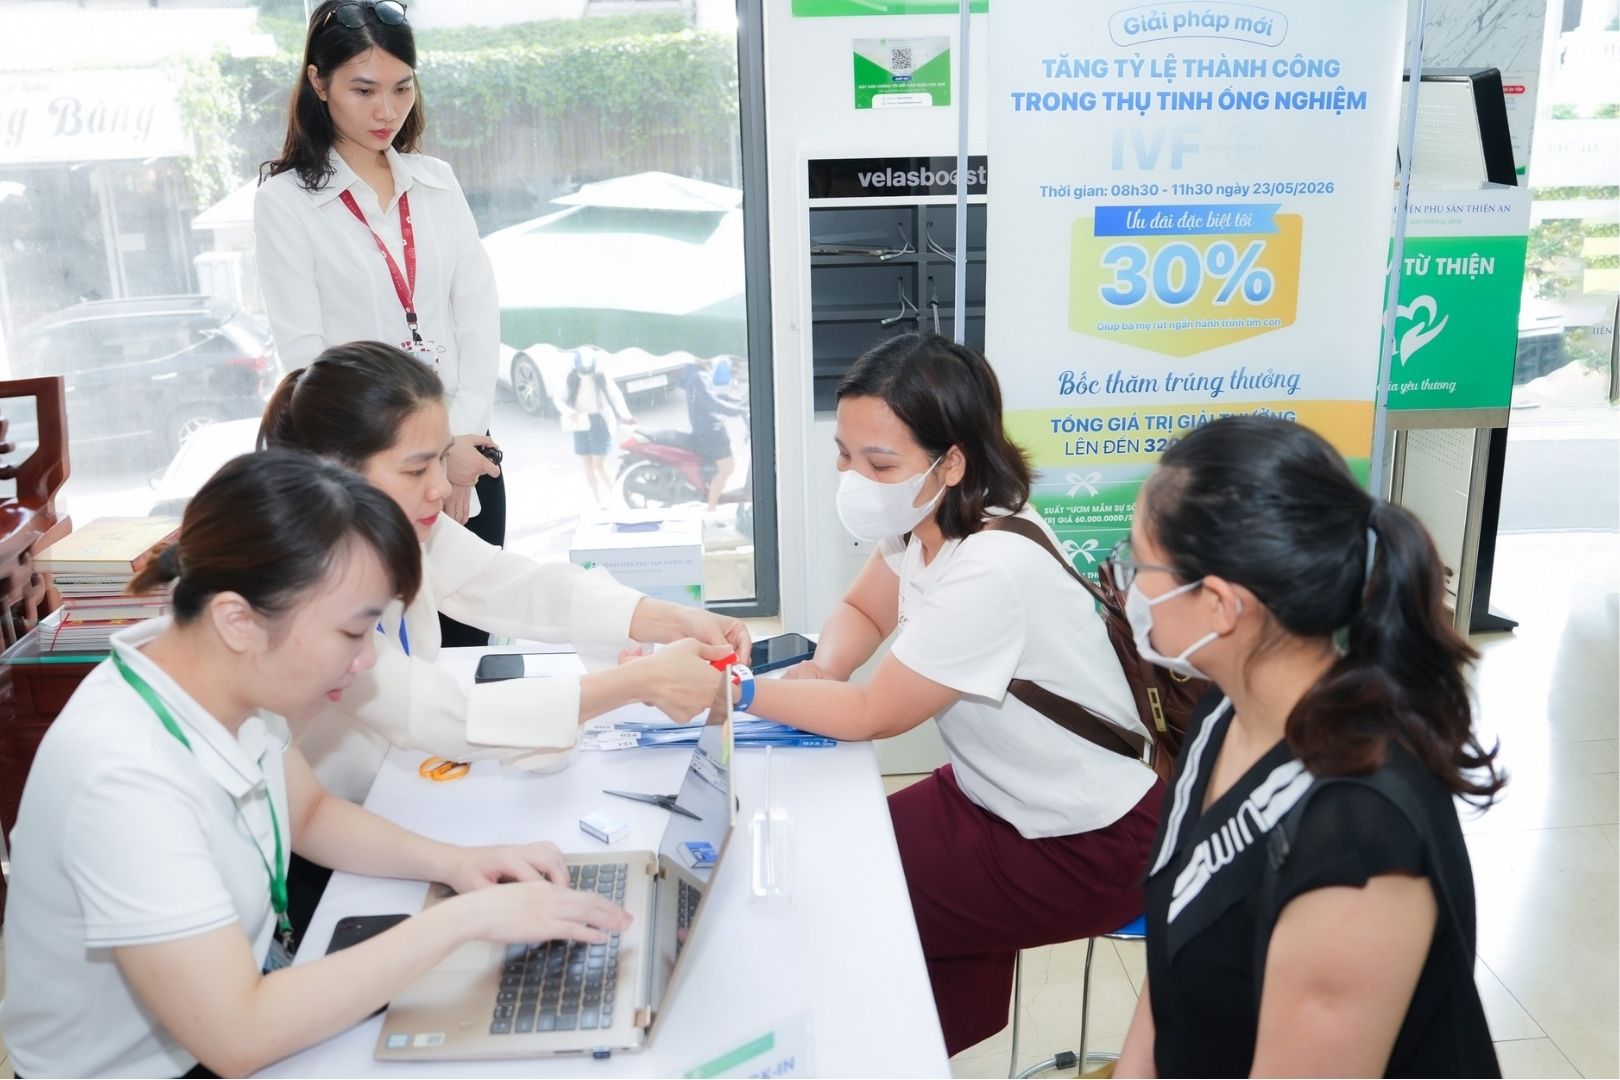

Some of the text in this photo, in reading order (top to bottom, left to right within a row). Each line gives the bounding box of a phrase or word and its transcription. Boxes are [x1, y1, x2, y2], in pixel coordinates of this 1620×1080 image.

[1123, 8, 1274, 37] Giải pháp mới
[1041, 52, 1341, 83] TĂNG TỶ LỆ THÀNH CÔNG
[1011, 85, 1367, 117] TRONG THỤ TINH ỐNG NGHIỆM
[1110, 122, 1199, 171] IVF
[1039, 184, 1072, 198] Thời
[1074, 185, 1108, 200] gian:
[1111, 183, 1159, 197] 08h30
[1171, 182, 1213, 196] 11h30
[1215, 184, 1250, 199] ngày
[1253, 181, 1335, 196] 23/05/2026
[1177, 210, 1203, 231] đặc
[1206, 209, 1235, 230] biệt
[1099, 239, 1276, 309] 30%
[1404, 252, 1431, 276] TỪ
[1435, 252, 1495, 280] THIỆN
[1058, 366, 1302, 398] Bốc thăm trúng thưởng
[1400, 380, 1418, 395] yêu
[1420, 378, 1457, 394] thương
[1107, 412, 1140, 432] GIÁ
[1144, 415, 1174, 434] TRỊ
[1065, 437, 1099, 456] LÊN
[1103, 435, 1140, 454] ĐẾN
